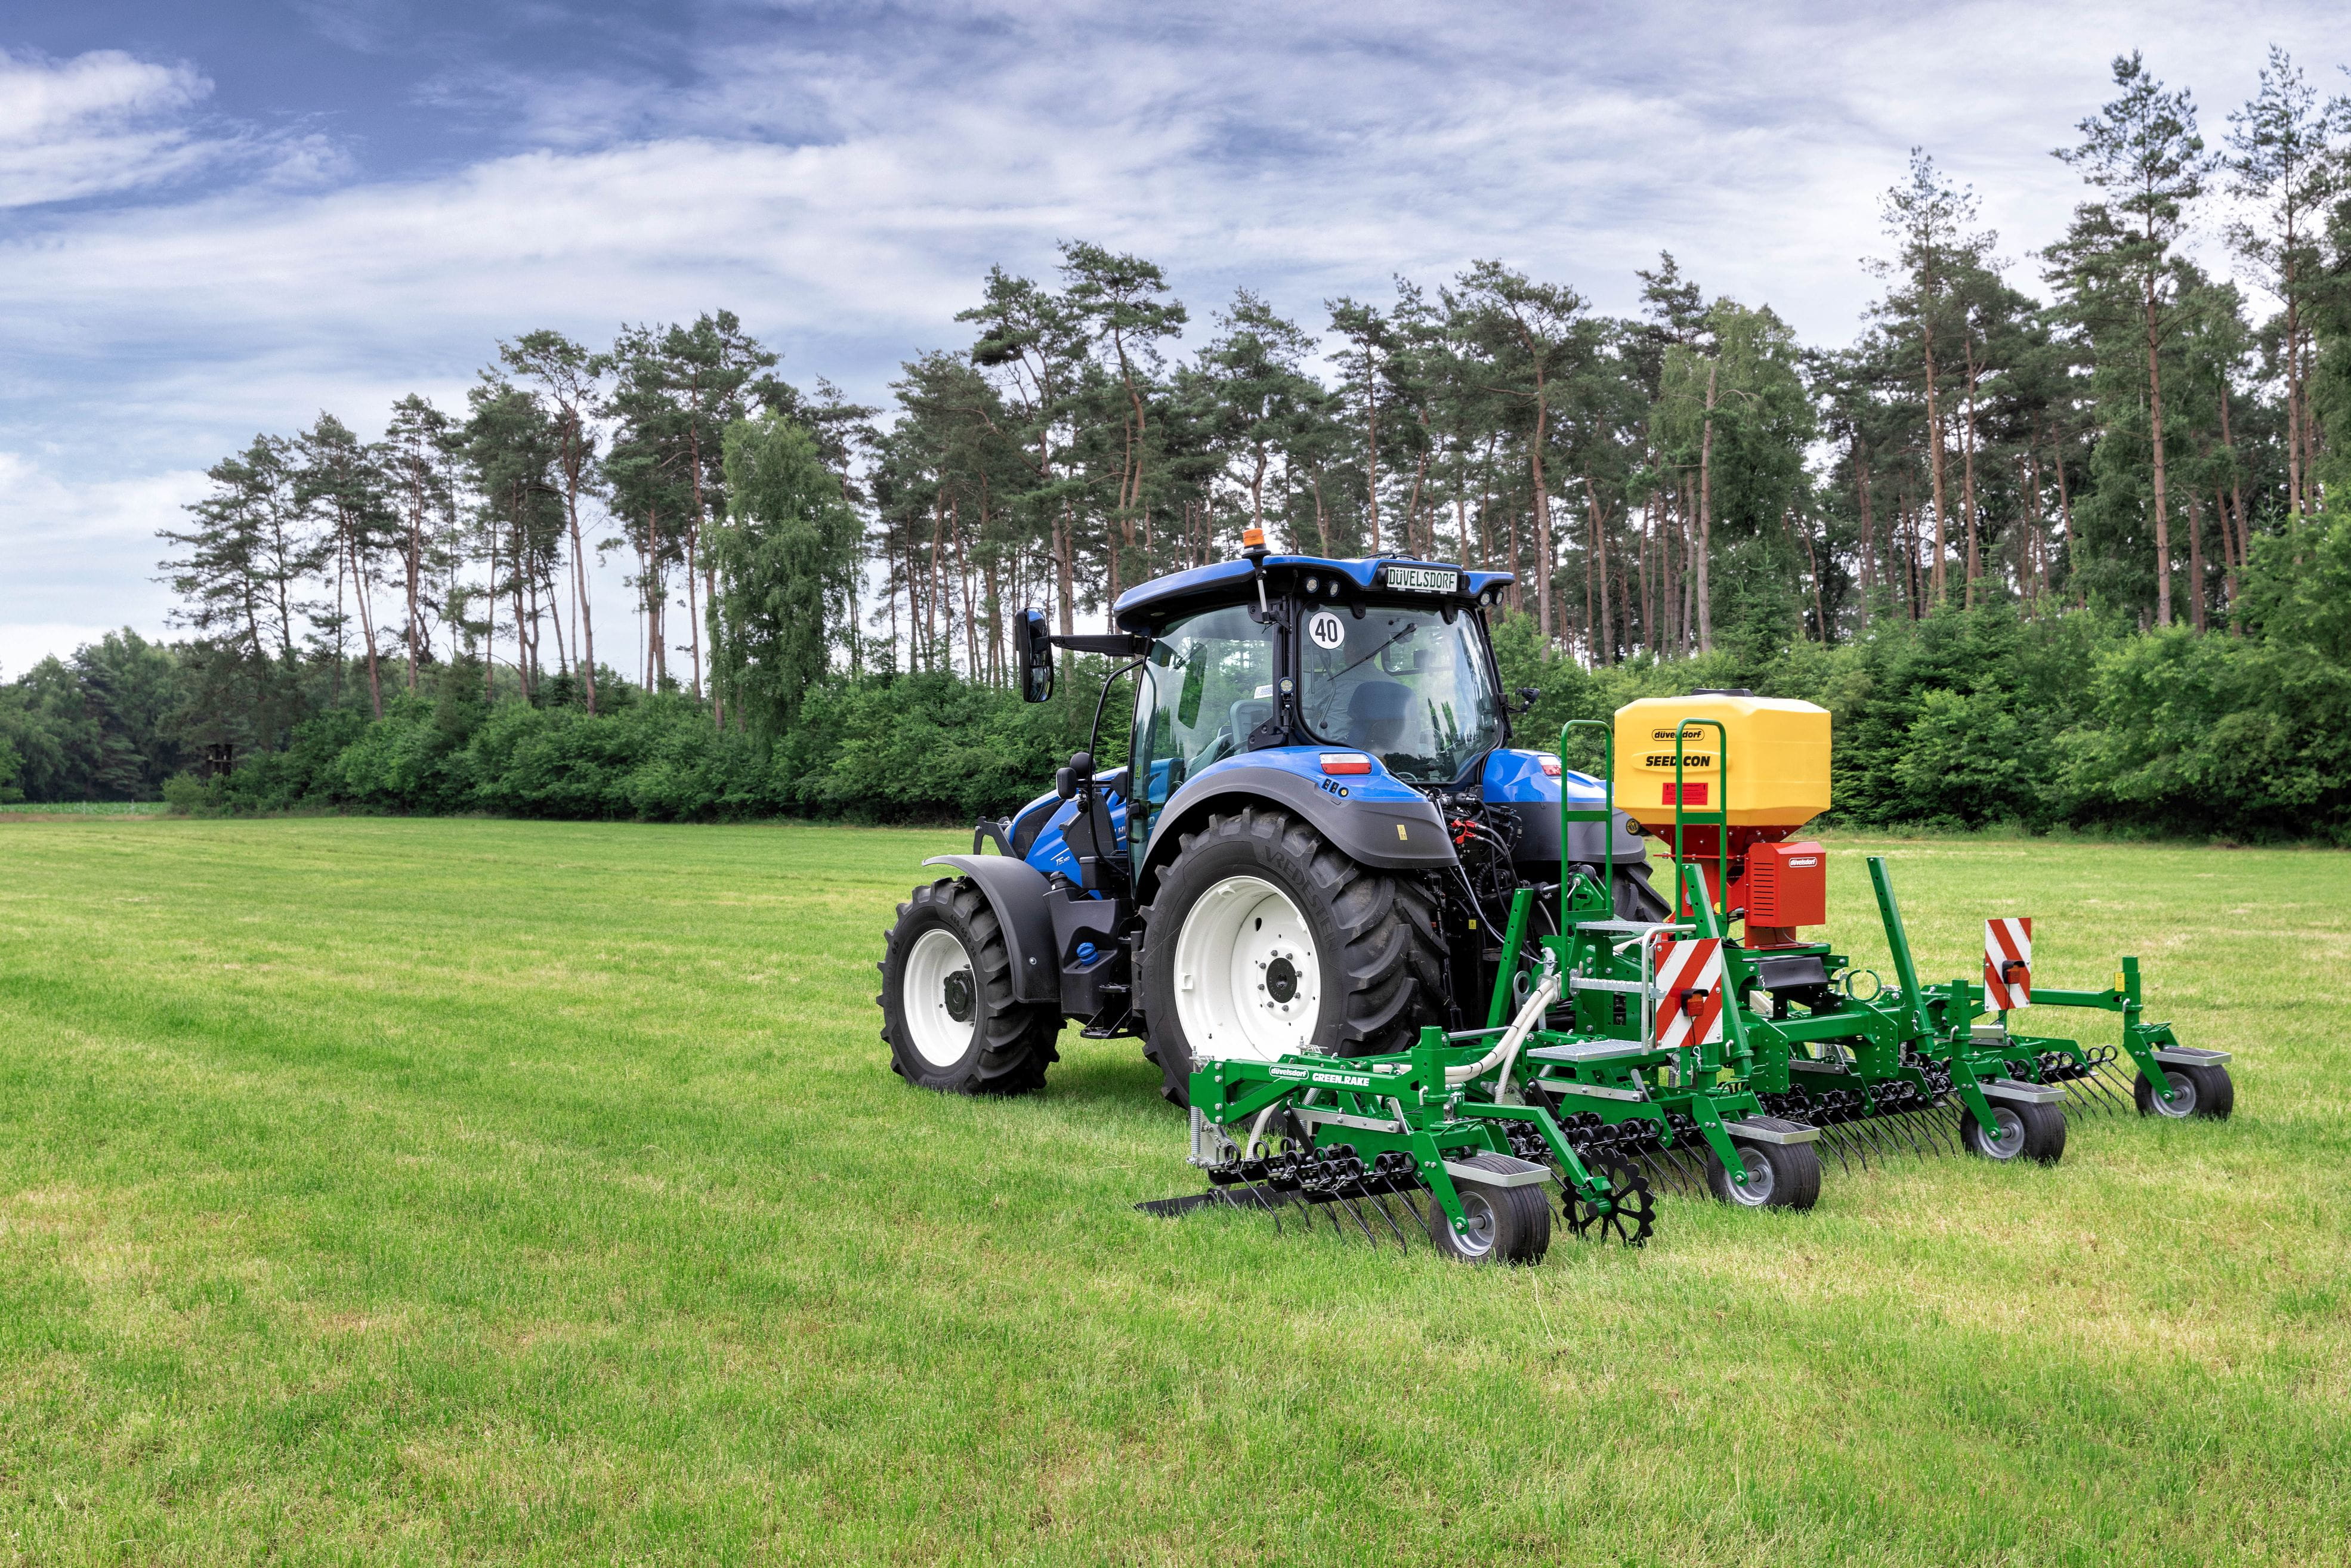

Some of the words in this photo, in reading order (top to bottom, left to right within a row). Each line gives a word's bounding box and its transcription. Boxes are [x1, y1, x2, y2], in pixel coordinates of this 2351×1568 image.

[1315, 618, 1338, 643] 40
[1271, 1068, 1307, 1077] düvelsdorf
[1312, 1073, 1370, 1087] GREEN.RAKE
